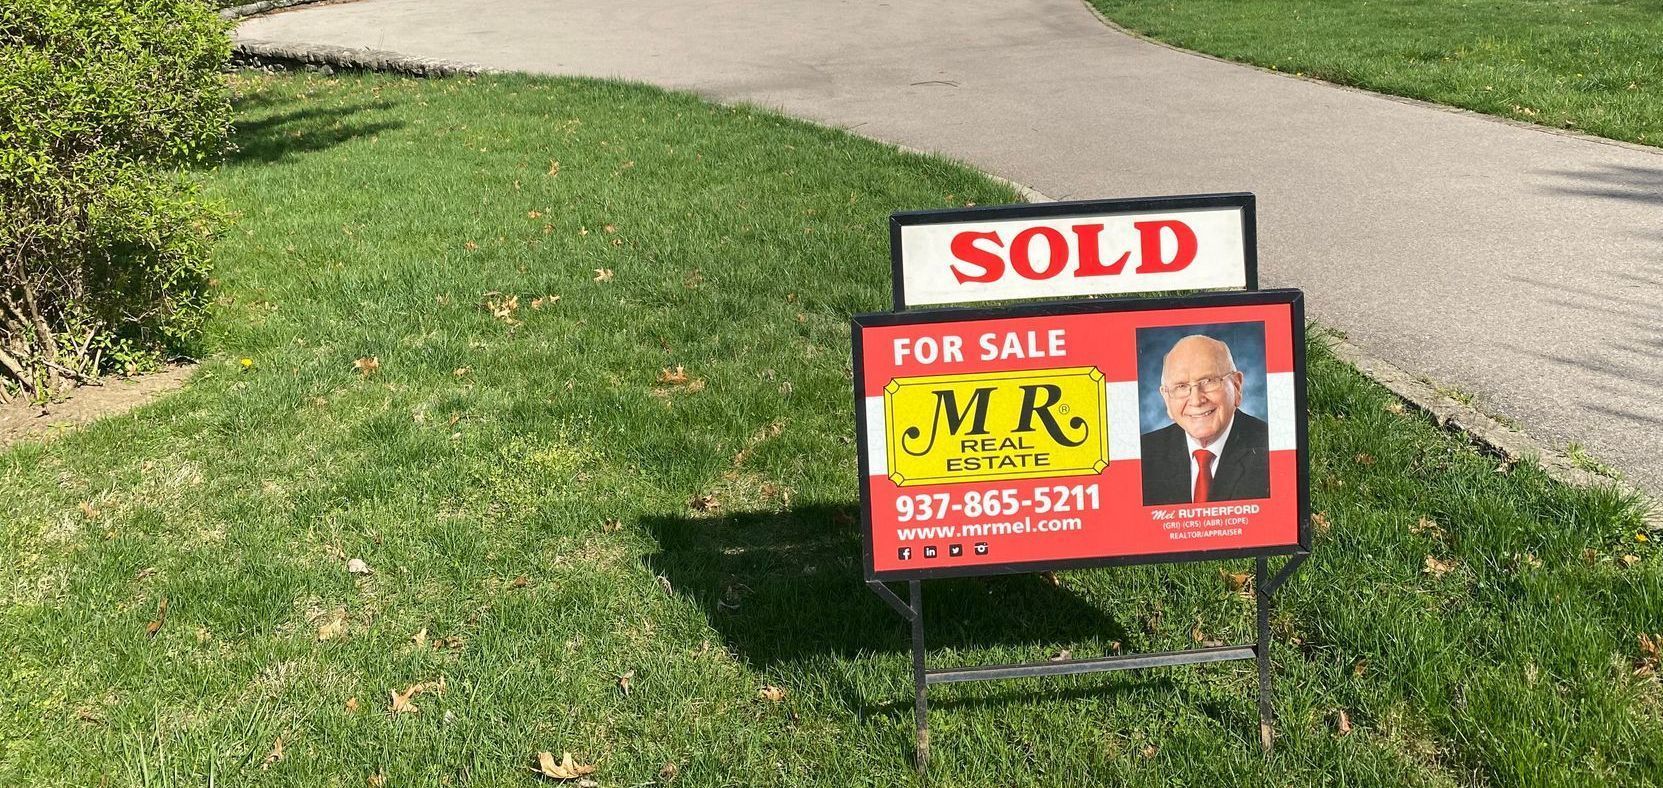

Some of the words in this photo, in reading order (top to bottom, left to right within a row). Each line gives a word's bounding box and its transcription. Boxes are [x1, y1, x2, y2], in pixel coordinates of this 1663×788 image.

[950, 219, 1198, 284] SOLD
[893, 335, 964, 366] FOR
[979, 329, 1067, 361] SALE
[961, 437, 1035, 453] REAL
[947, 453, 1050, 472] ESTATE
[896, 484, 1100, 522] 937-865-5211
[1178, 504, 1259, 518] RUTHERFORD
[897, 517, 1082, 540] www.mrmel.com
[1203, 518, 1223, 527] (ABR)
[1225, 517, 1249, 526] (CDPE)
